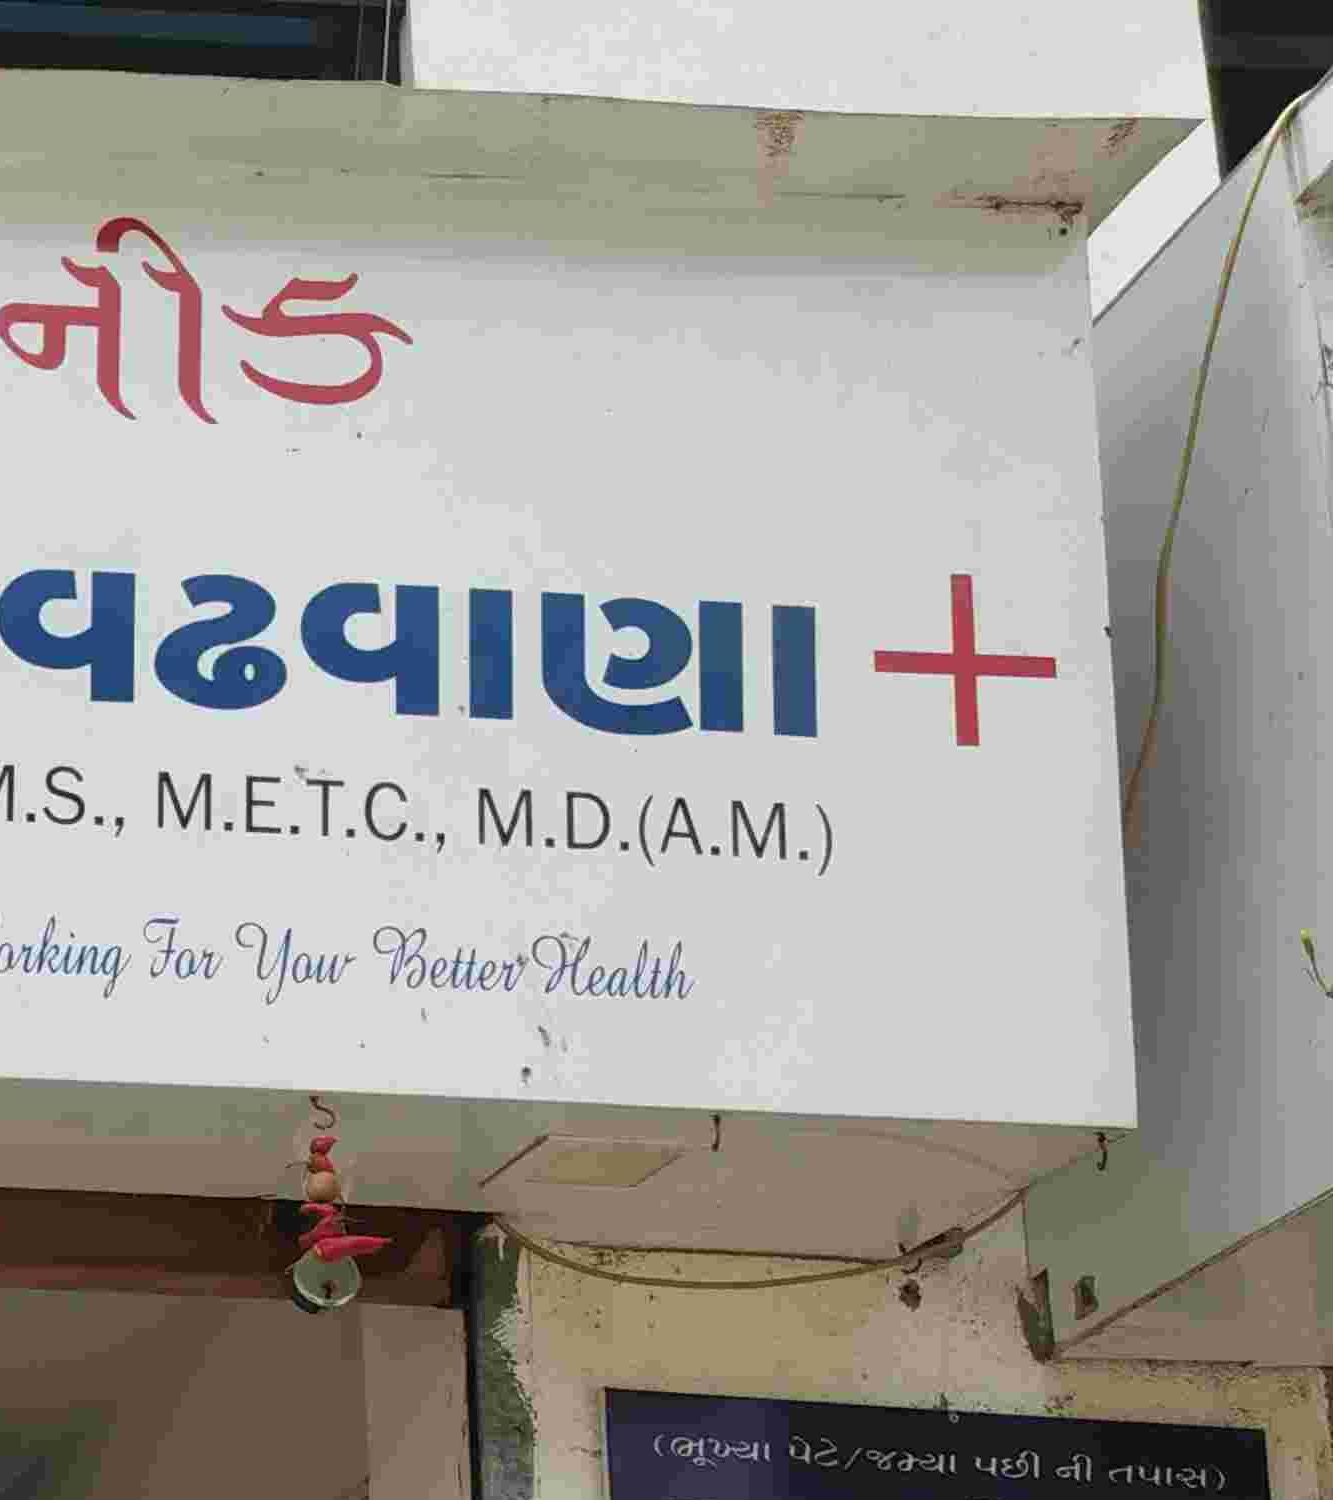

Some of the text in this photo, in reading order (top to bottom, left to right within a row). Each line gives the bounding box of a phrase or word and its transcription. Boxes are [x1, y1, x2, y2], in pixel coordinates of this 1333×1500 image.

[155, 771, 447, 850] M.E.T.C.,
[476, 787, 835, 876] M.D.(A.M.)
[143, 917, 223, 979] For
[234, 921, 356, 1005] Your
[373, 926, 529, 992] Better
[532, 933, 695, 1000] Health
[974, 1450, 1039, 1480] પછી
[1055, 1453, 1093, 1483] ની
[1107, 1463, 1226, 1491] તપાસ)
